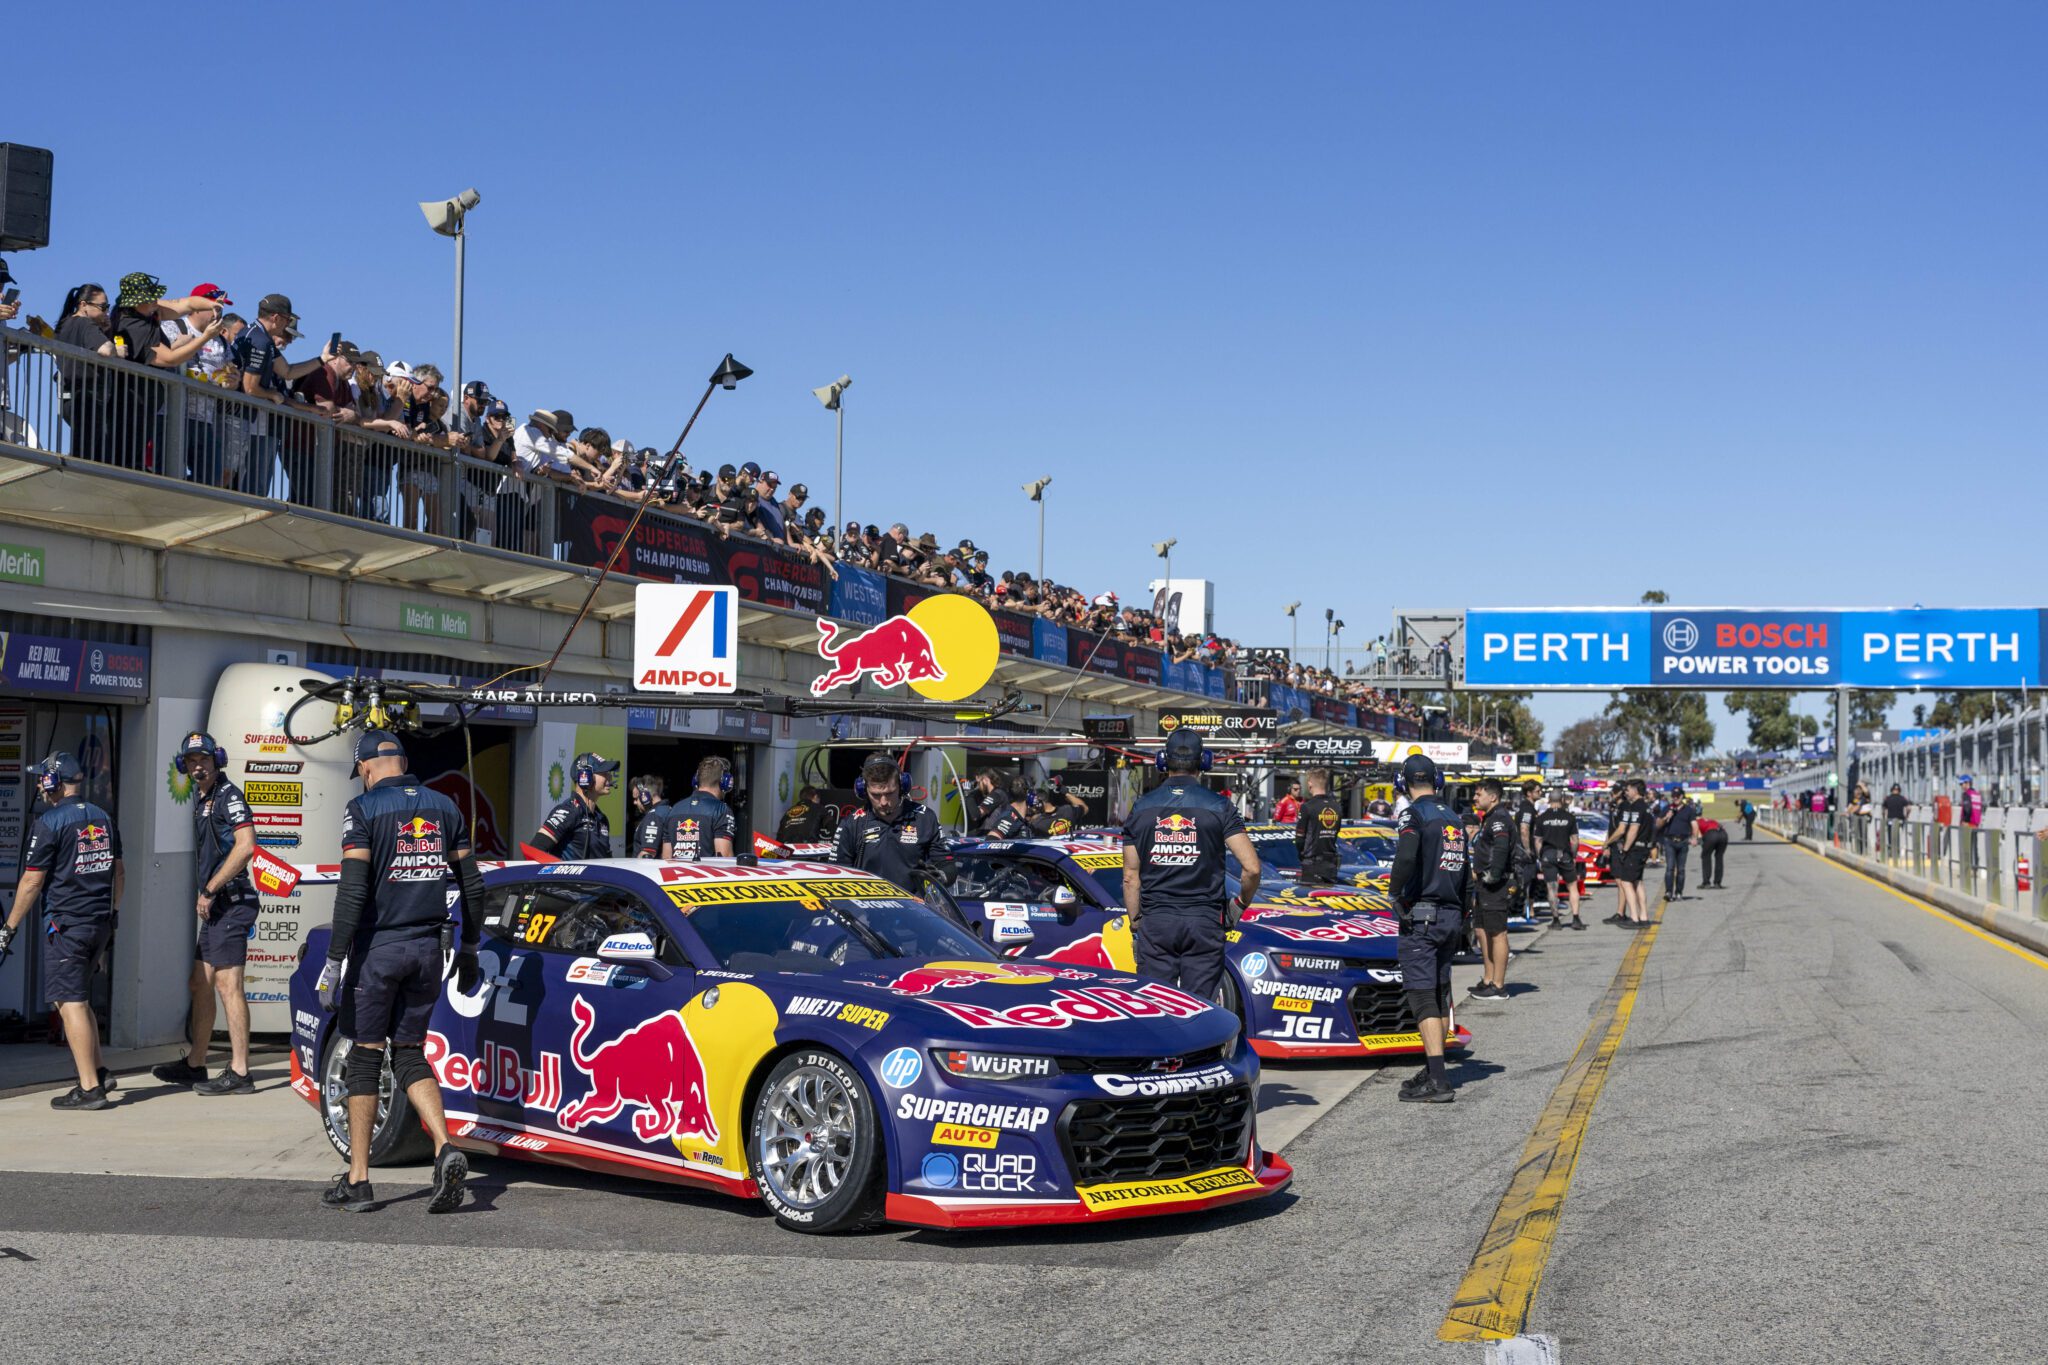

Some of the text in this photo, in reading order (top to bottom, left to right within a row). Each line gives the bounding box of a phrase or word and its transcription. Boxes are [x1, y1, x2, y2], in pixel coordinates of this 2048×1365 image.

[635, 524, 708, 557] SUPERCARS
[636, 548, 710, 576] CHAMPIONSHIP
[763, 557, 821, 585] SUPERCARS
[844, 581, 886, 610] WESTERN
[406, 606, 467, 634] Merlin Merlin
[1716, 624, 1828, 648] BOSCH
[28, 645, 60, 663] RED BULL
[1484, 632, 1629, 662] PERTH
[1863, 632, 2019, 662] PERTH
[18, 662, 70, 682] AMPOL RACING
[107, 654, 143, 672] BOSCH
[1664, 656, 1830, 675] POWER TOOLS
[90, 673, 142, 688] POWER TOOLS
[640, 670, 732, 688] AMPOL
[1182, 715, 1222, 724] PENRITE
[1224, 717, 1276, 728] GROVE
[1295, 737, 1362, 750] erebus
[249, 763, 298, 772] ToolPRO
[248, 784, 300, 792] NATIONAL
[249, 794, 297, 802] STORAGE
[252, 816, 270, 824] arvey
[396, 838, 442, 853] Red Bull
[1155, 831, 1196, 843] Red Bull
[76, 852, 114, 863] AMPOL
[1150, 845, 1200, 854] AMPOL
[74, 860, 112, 873] RACING
[390, 855, 448, 867] AMPOL
[1150, 855, 1198, 863] RACING
[253, 854, 296, 886] SUPERCHEAP
[388, 868, 445, 879] RACING
[552, 866, 588, 875] BROWN
[262, 876, 278, 886] AUTO
[667, 881, 904, 904] NATIONAL STORAGE
[800, 899, 824, 911] 87
[850, 898, 904, 909] Brown
[259, 922, 298, 932] QUAD
[525, 914, 556, 944] 87
[259, 932, 297, 941] LOCK
[604, 941, 652, 950] ACDelco
[704, 970, 754, 979] DUNLOP
[1243, 954, 1266, 977] hp
[1252, 979, 1342, 1003] SUPERCHEAP
[916, 982, 1215, 1029] Red Bull
[1277, 999, 1308, 1008] AUTO
[785, 996, 890, 1031] MAKE IT SUPER
[1273, 1016, 1333, 1039] JGI
[1365, 1034, 1422, 1045] NATIONAL
[424, 1030, 562, 1113] Red Bull
[806, 1054, 859, 1099] DUNLOP
[886, 1048, 918, 1088] hp
[766, 1082, 776, 1096] RF
[1093, 1070, 1234, 1096] COMPLETE
[897, 1094, 1049, 1132] SUPERCHEAP
[327, 1127, 348, 1155] MAXX
[471, 1126, 549, 1150] NEW HOLLAND
[939, 1129, 991, 1143] AUTO
[702, 1152, 724, 1165] Repco
[963, 1154, 1036, 1173] QUAD
[962, 1173, 1035, 1192] LOCK
[1086, 1171, 1252, 1204] NATIONAL STORAGE
[756, 1175, 814, 1222] SPORT MAXX
